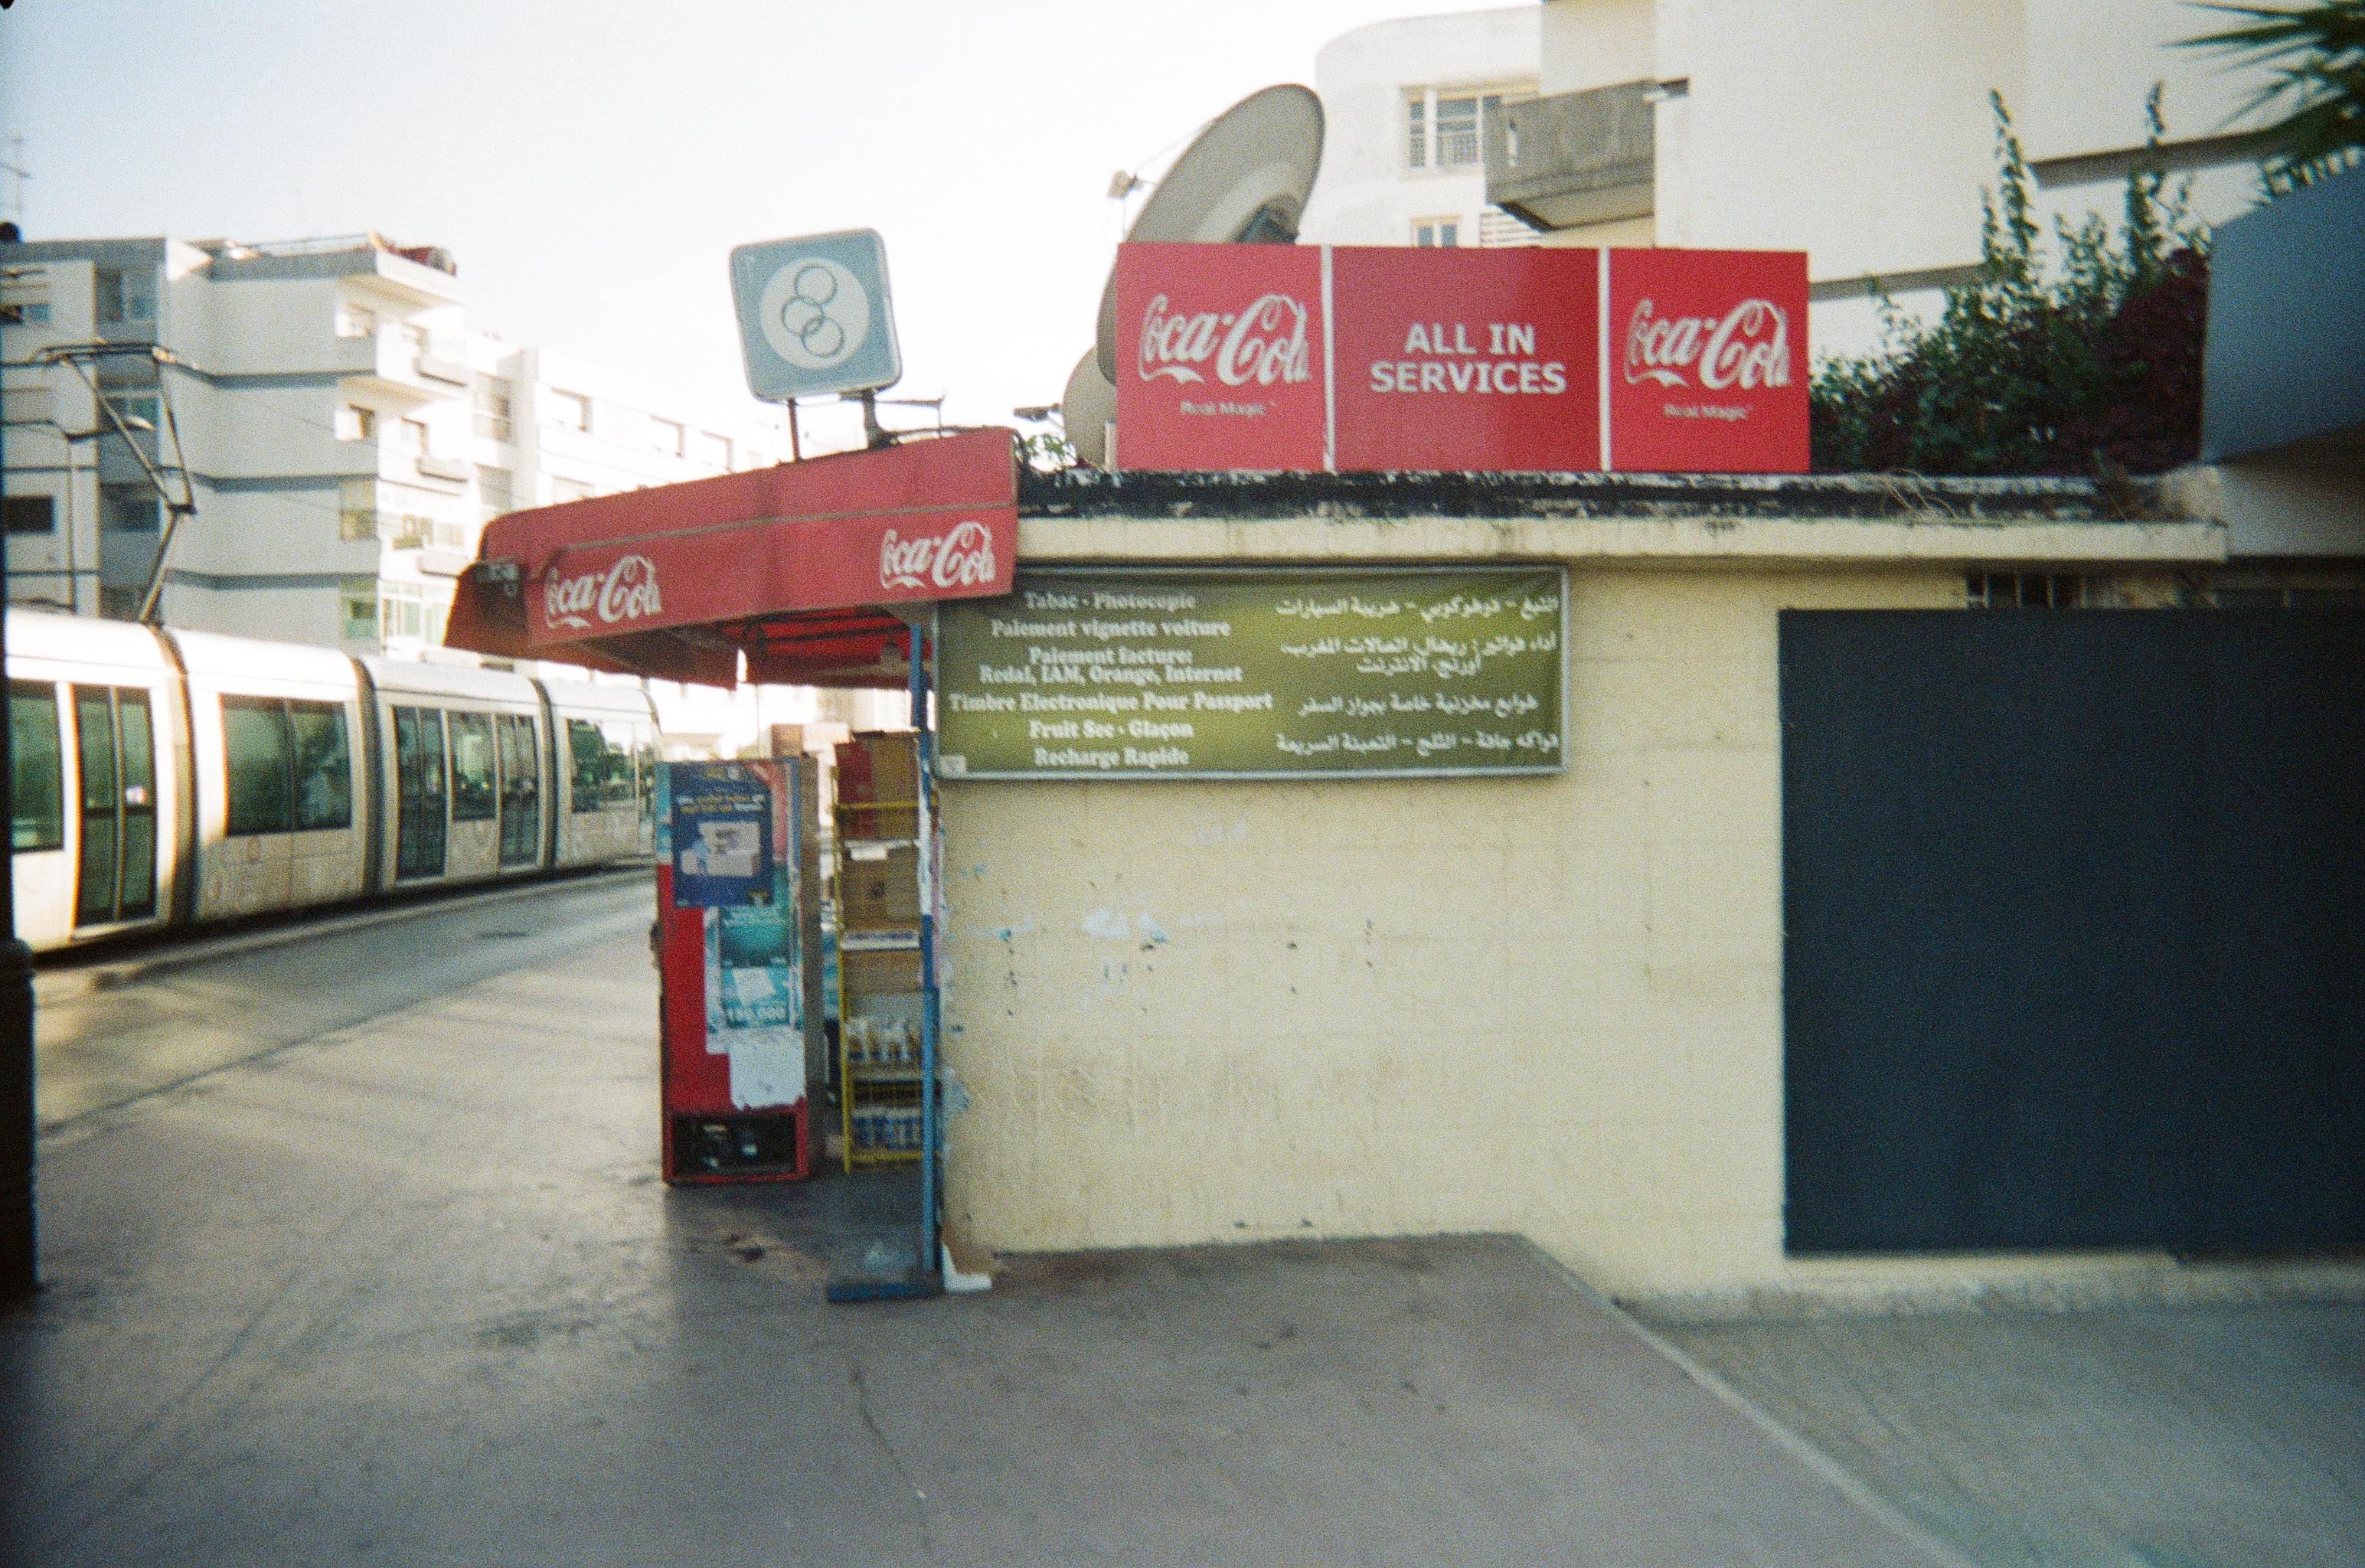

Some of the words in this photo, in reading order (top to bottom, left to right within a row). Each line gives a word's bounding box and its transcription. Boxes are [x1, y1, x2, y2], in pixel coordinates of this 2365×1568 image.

[1138, 293, 1310, 386] Coca-Cola
[1405, 322, 1477, 354] ALL
[1488, 322, 1534, 354] IN
[1624, 298, 1790, 390] Coca-Cola
[1370, 361, 1566, 394] SERVICES
[880, 520, 995, 590] Coca-Cola
[544, 554, 663, 629] Coca-Cola
[1080, 619, 1157, 640] vignette
[1161, 619, 1230, 636] voiture
[1165, 665, 1242, 682] Internet
[949, 693, 1016, 711] Timbre
[1143, 691, 1189, 710] Pour
[1029, 720, 1079, 739] Fruit
[1083, 720, 1114, 738] Sec
[1034, 746, 1119, 769] Recharge
[1124, 747, 1189, 769] Rapide
